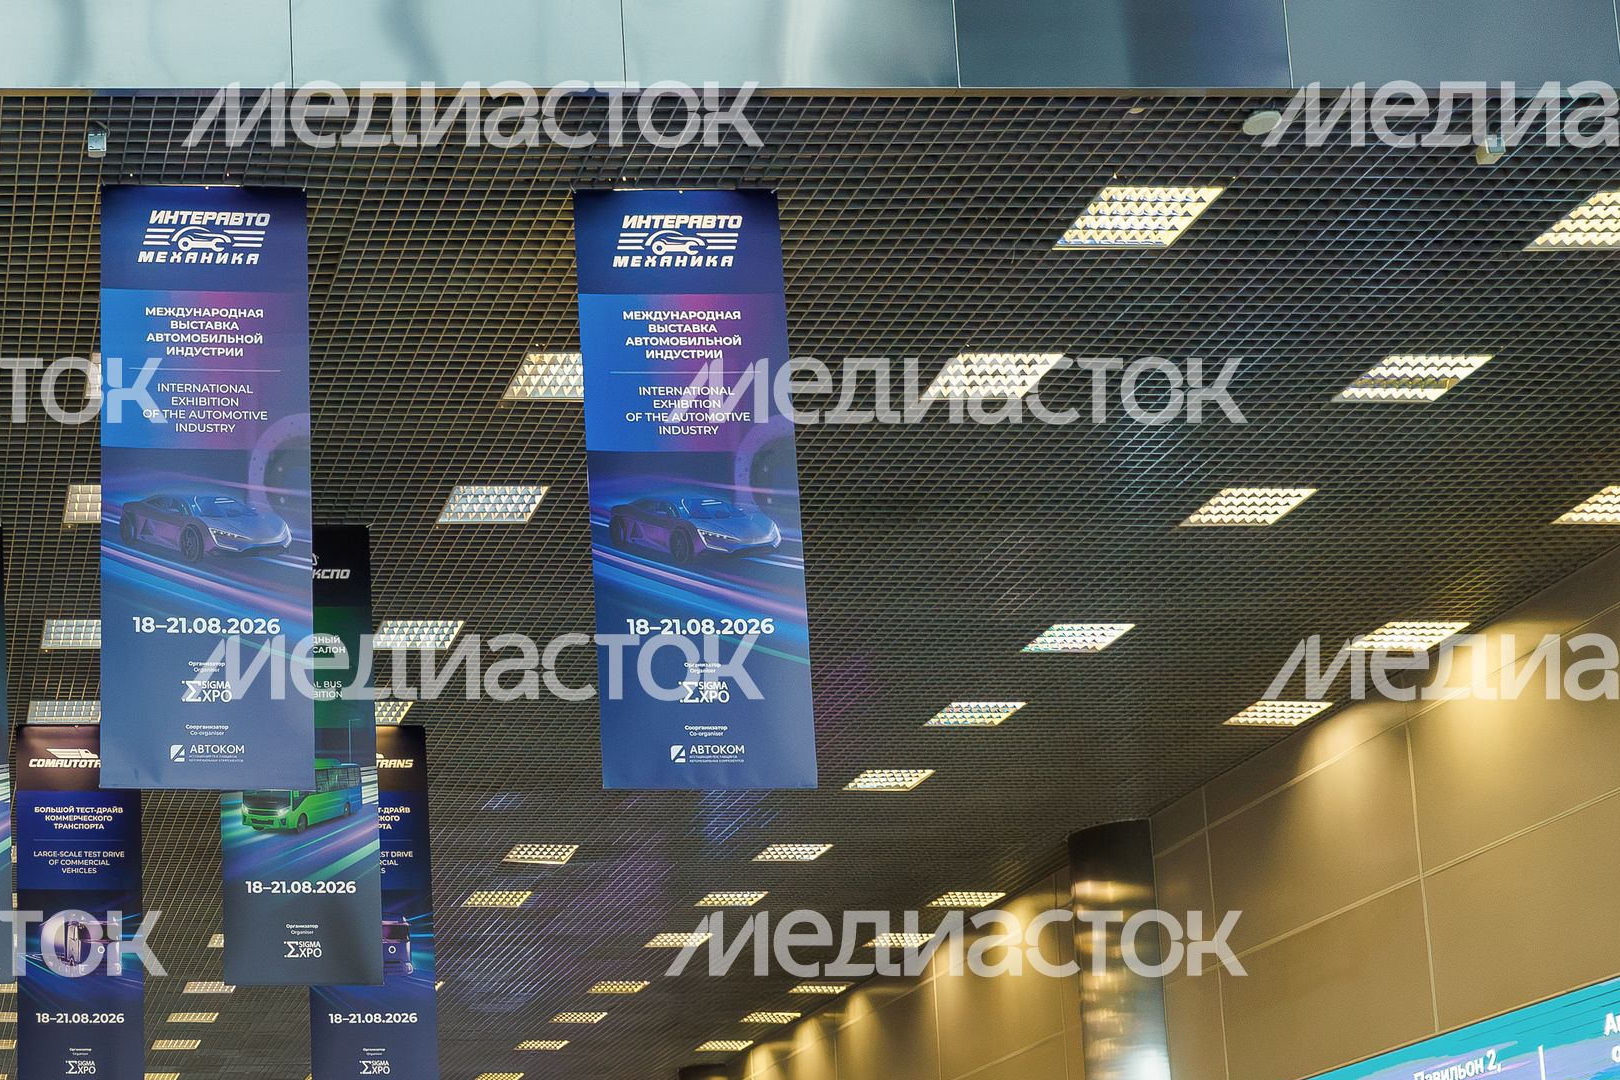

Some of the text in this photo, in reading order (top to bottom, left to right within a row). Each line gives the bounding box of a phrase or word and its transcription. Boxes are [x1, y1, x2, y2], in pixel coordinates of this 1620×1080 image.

[150, 210, 270, 226] ИНТЕРАВТО
[622, 215, 742, 229] ИНТЕРАВТО
[138, 251, 259, 265] МЕХАНИКА
[613, 255, 734, 268] МЕХАНИКА
[145, 307, 264, 318] МЕЖДУНАРОДНАЯ
[623, 311, 741, 321] МЕЖДУНАРОДНАЯ
[170, 321, 239, 330] ВЫСТАВКА
[146, 332, 263, 344] АВТОМОБИЛЬНОЙ
[626, 335, 742, 346] АВТОМОБИЛЬНОЙ
[166, 347, 244, 357] ИНДУСТРИИ
[157, 383, 253, 394] INTERNATIONAL
[189, 410, 268, 420] AUTOMOTIVE
[190, 745, 245, 754] АВТОКОМ
